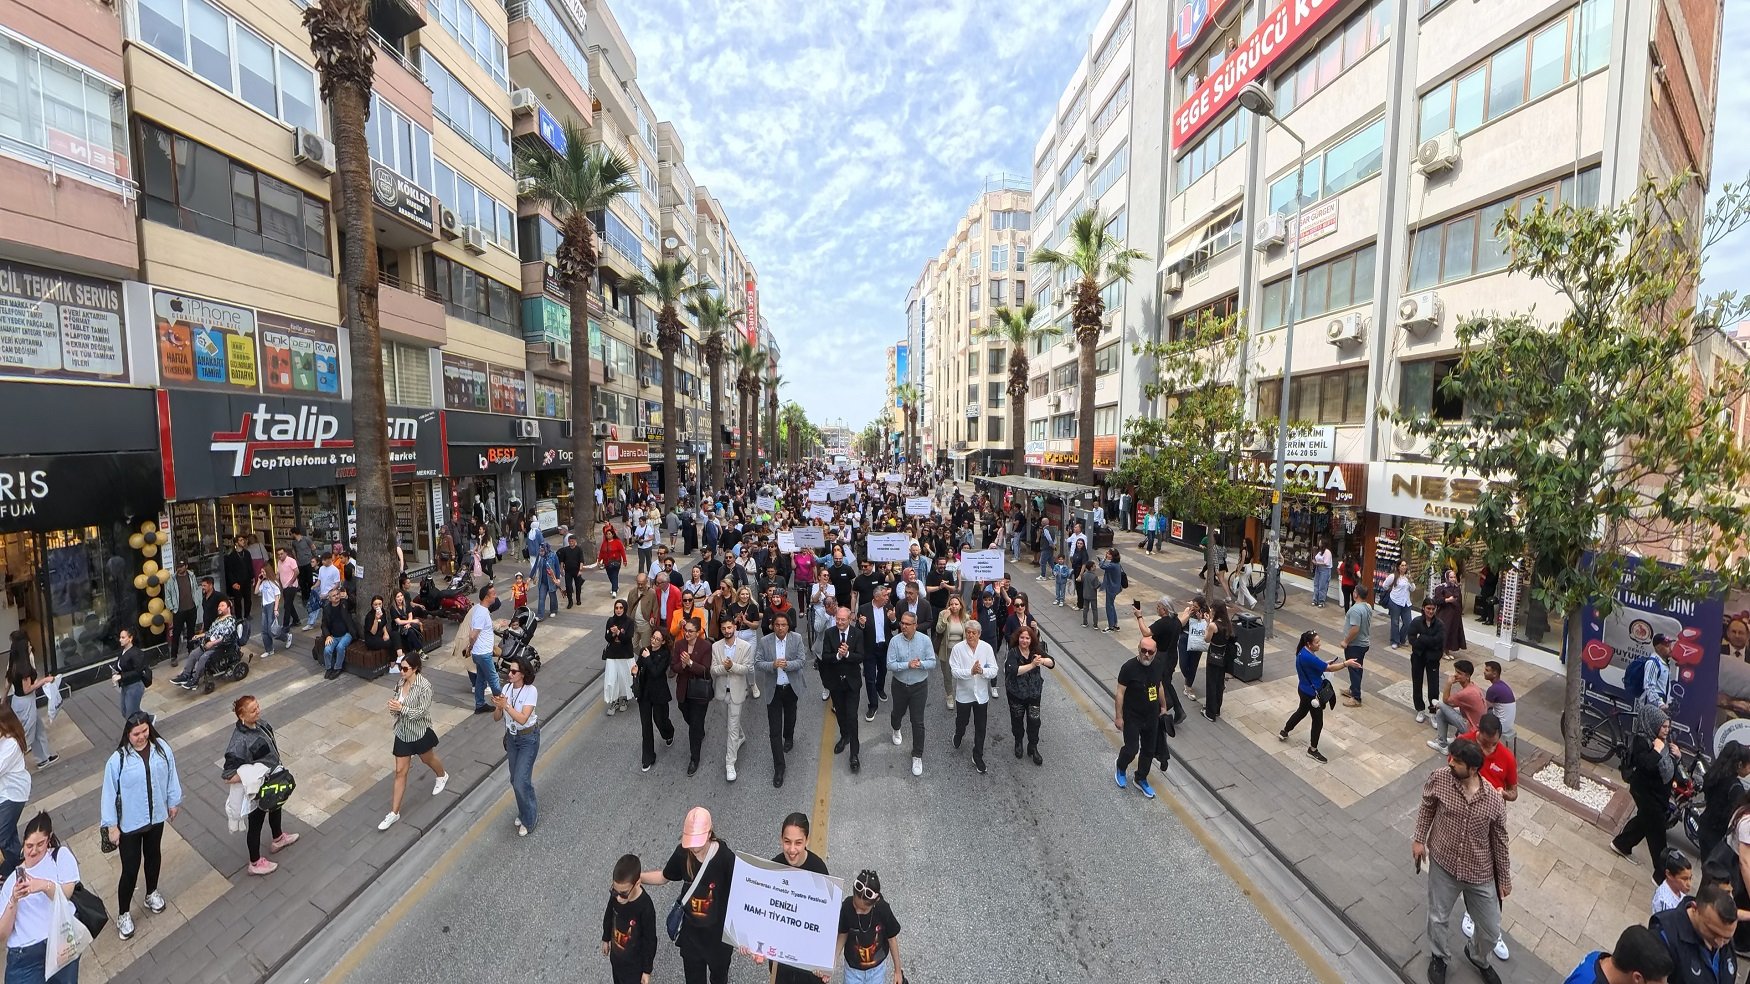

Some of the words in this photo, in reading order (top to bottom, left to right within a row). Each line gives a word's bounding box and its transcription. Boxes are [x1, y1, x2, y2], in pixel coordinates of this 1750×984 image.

[1181, 89, 1210, 135] EGE
[1213, 7, 1288, 103] SÜRÜCÜ
[397, 179, 431, 208] KÖKLER
[0, 265, 21, 294] CİL
[23, 274, 73, 303] TEKNİK
[76, 285, 119, 310] SERVİS
[187, 299, 241, 323] iPhone
[69, 323, 90, 332] TABLET
[70, 332, 91, 341] LAPTOP
[253, 403, 339, 448] talip
[1285, 440, 1306, 449] ERRİN
[1309, 440, 1328, 449] EMİL
[329, 454, 338, 464] &
[489, 447, 517, 463] BEST
[619, 449, 637, 458] Jeans
[416, 469, 437, 477] MERKEZ
[0, 470, 49, 500] RIS
[0, 502, 36, 518] FUM
[1664, 597, 1695, 616] DİN!
[772, 885, 790, 895] Amatör
[790, 890, 807, 899] Tiyatro
[807, 894, 827, 905] Festivali
[769, 898, 798, 913] DENİZLİ
[744, 903, 767, 917] NAM-I
[768, 911, 801, 928] TİYATRO
[803, 921, 821, 933] DER.
